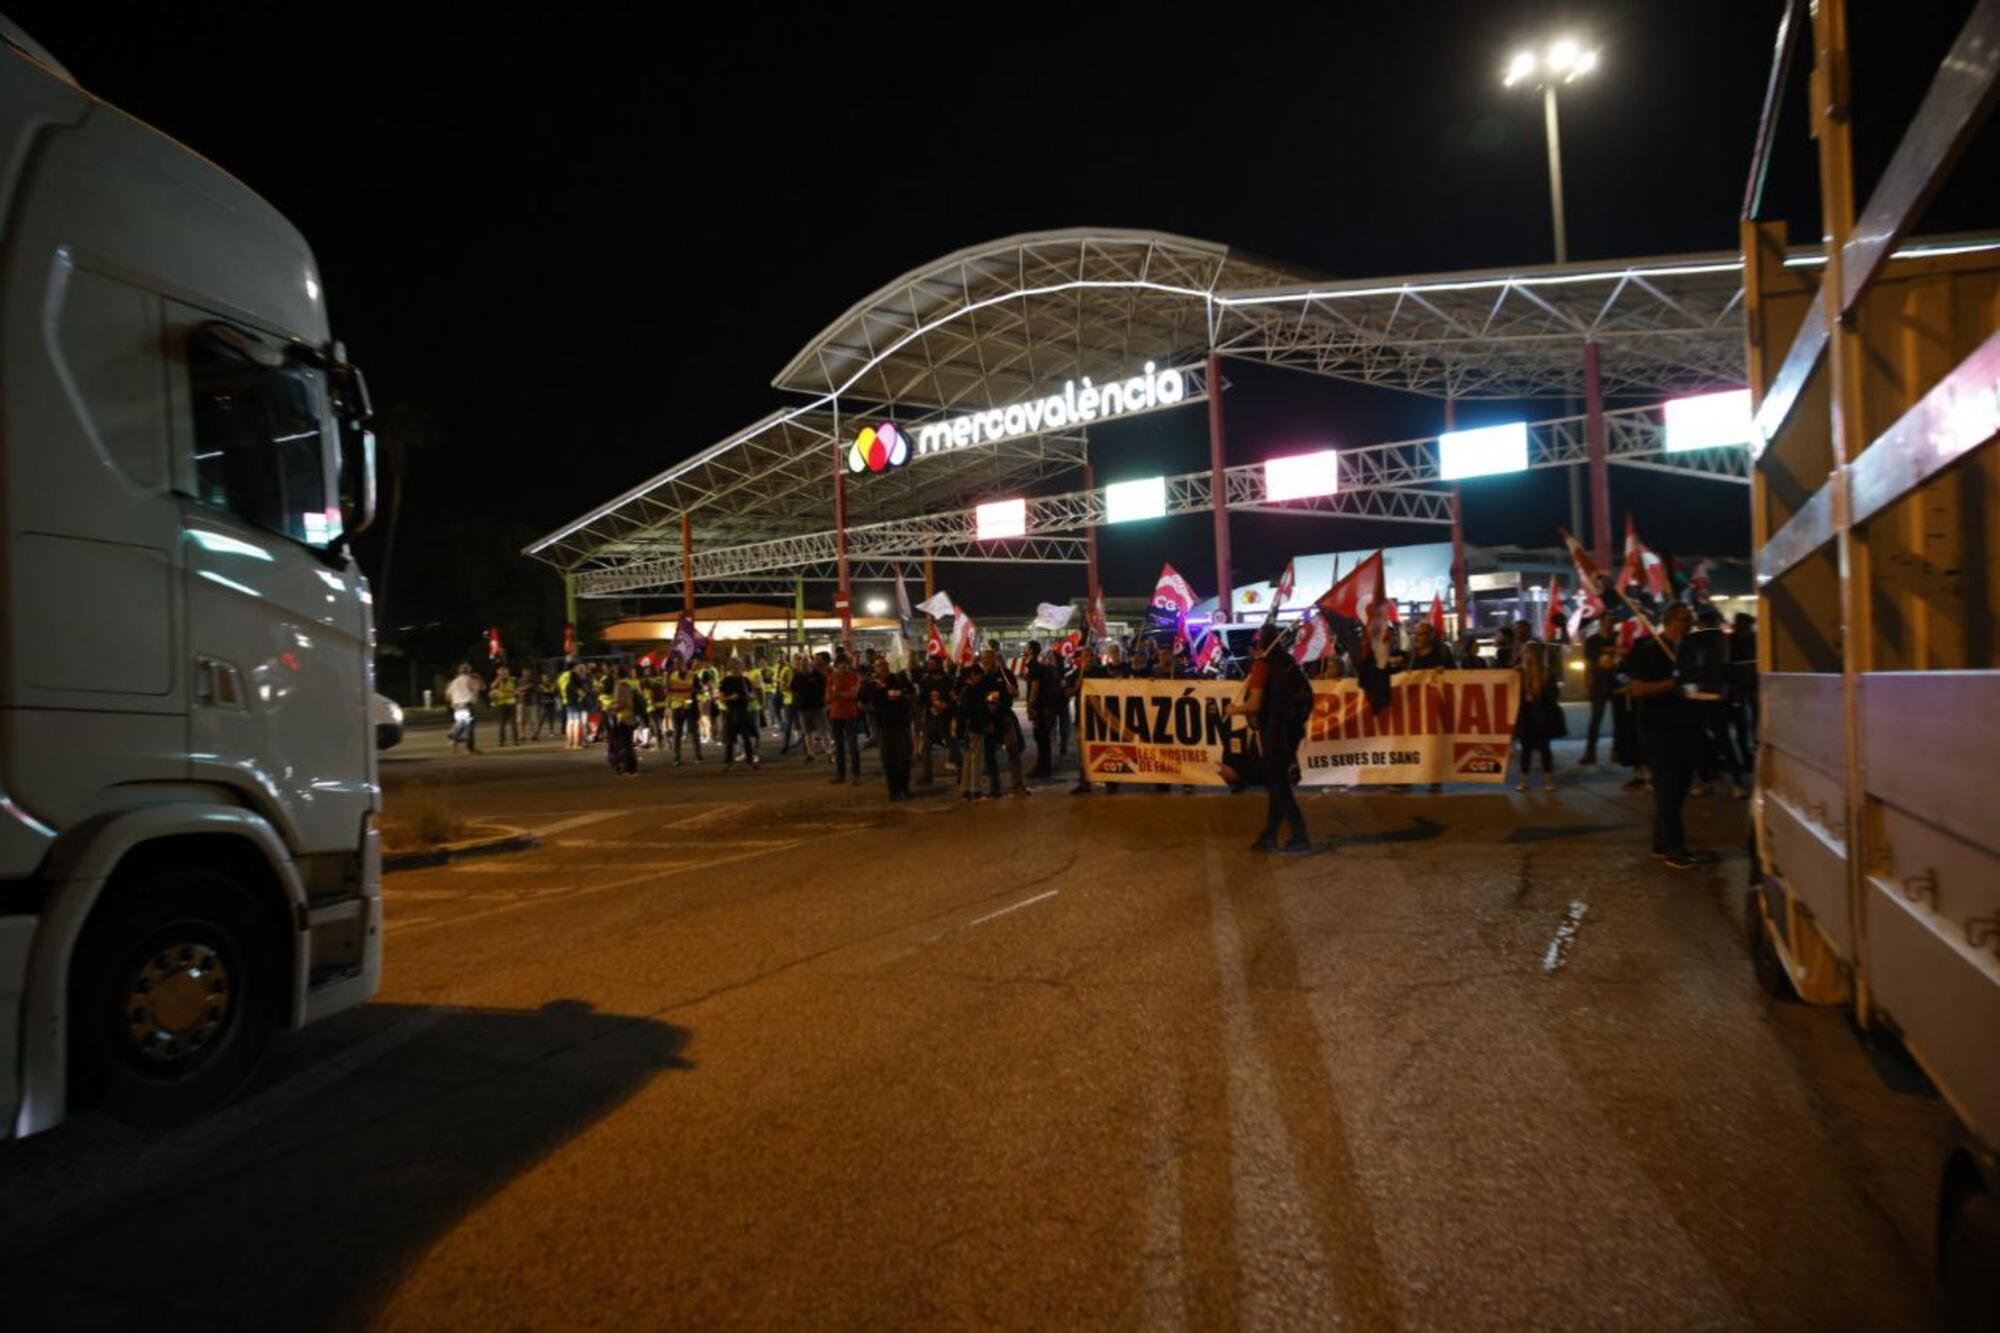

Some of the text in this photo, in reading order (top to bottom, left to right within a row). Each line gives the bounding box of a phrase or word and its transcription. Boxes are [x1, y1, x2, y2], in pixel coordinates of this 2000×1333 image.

[919, 361, 1184, 455] mercavalència
[1085, 683, 1515, 746] MAZÓN RIMINAL
[1308, 750, 1421, 769] LES SEUES DE SANG
[1469, 761, 1495, 772] CGT
